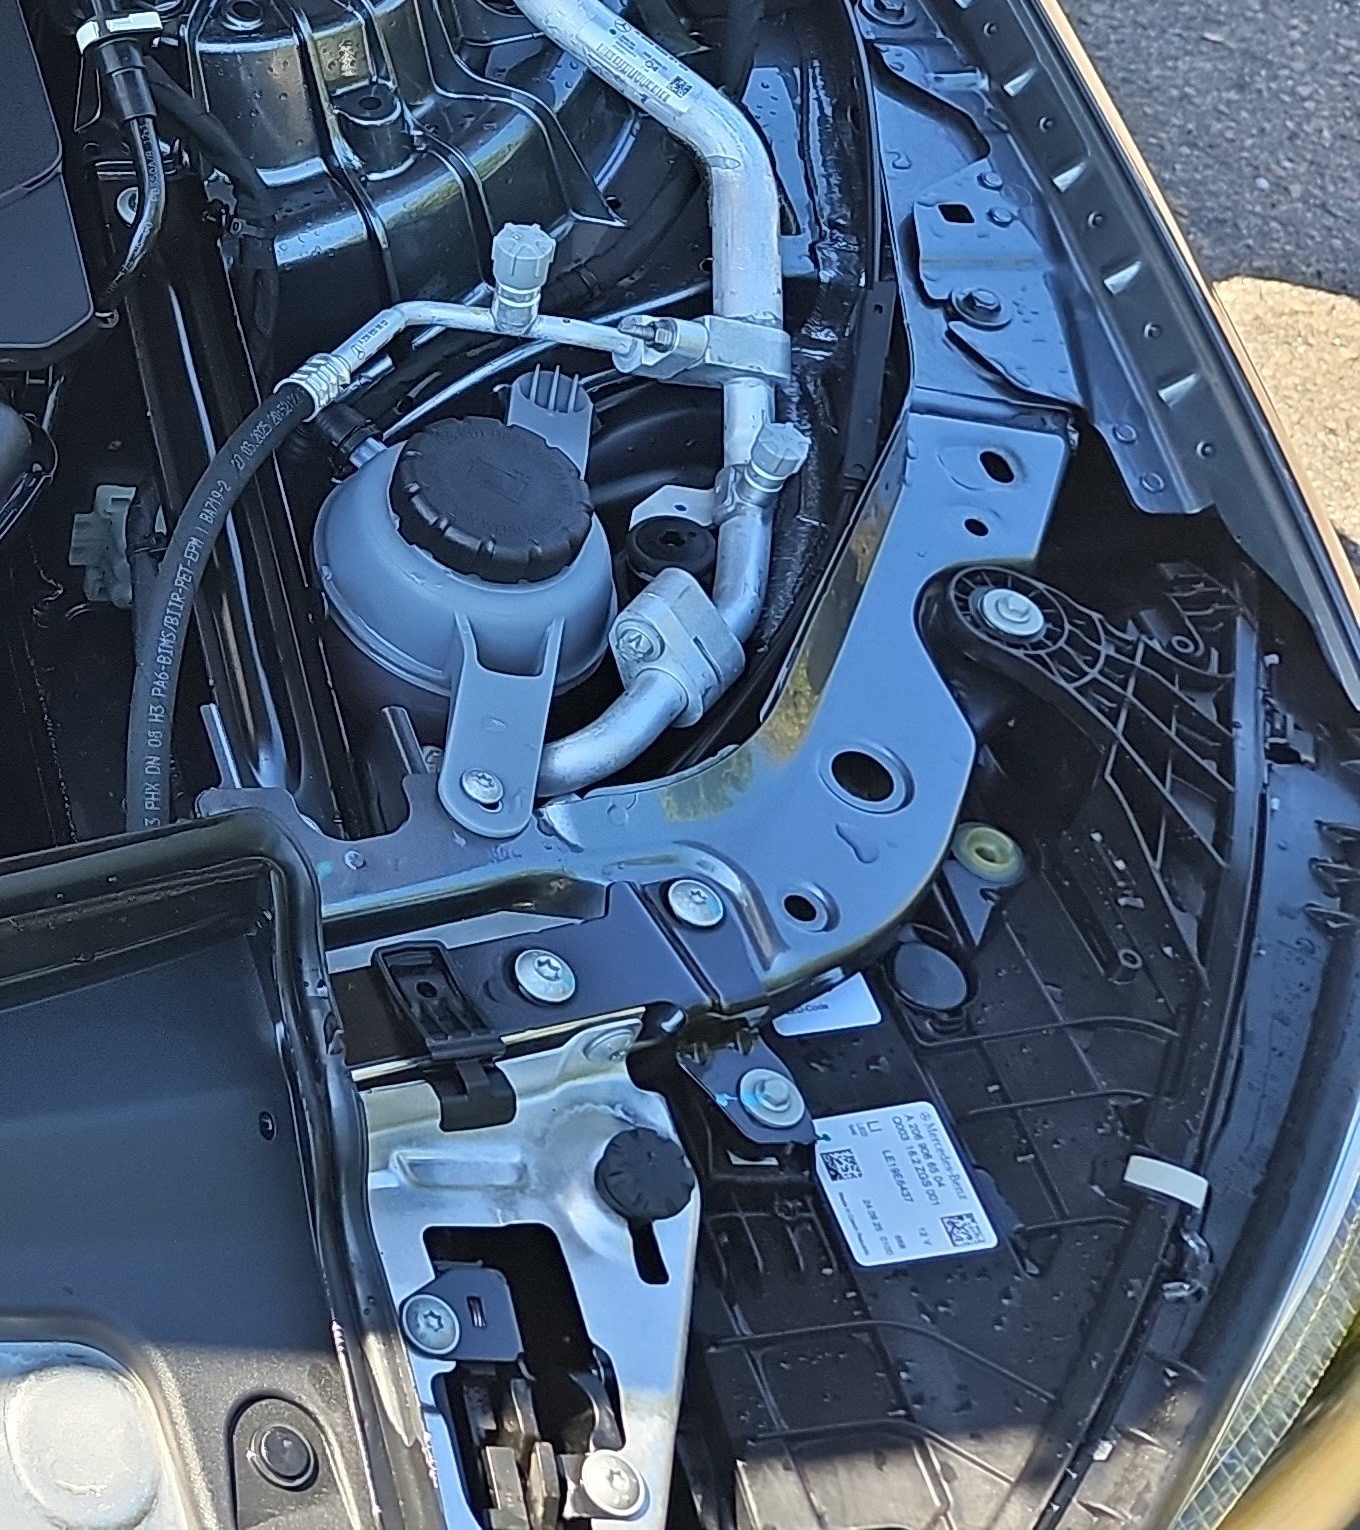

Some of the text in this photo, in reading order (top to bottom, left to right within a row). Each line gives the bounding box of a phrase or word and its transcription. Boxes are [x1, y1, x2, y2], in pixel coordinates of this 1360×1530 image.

[907, 1123, 924, 1140] 206
[933, 1175, 946, 1187] 04
[927, 1123, 968, 1199] Mercedes-Benz
[925, 1189, 941, 1205] 001
